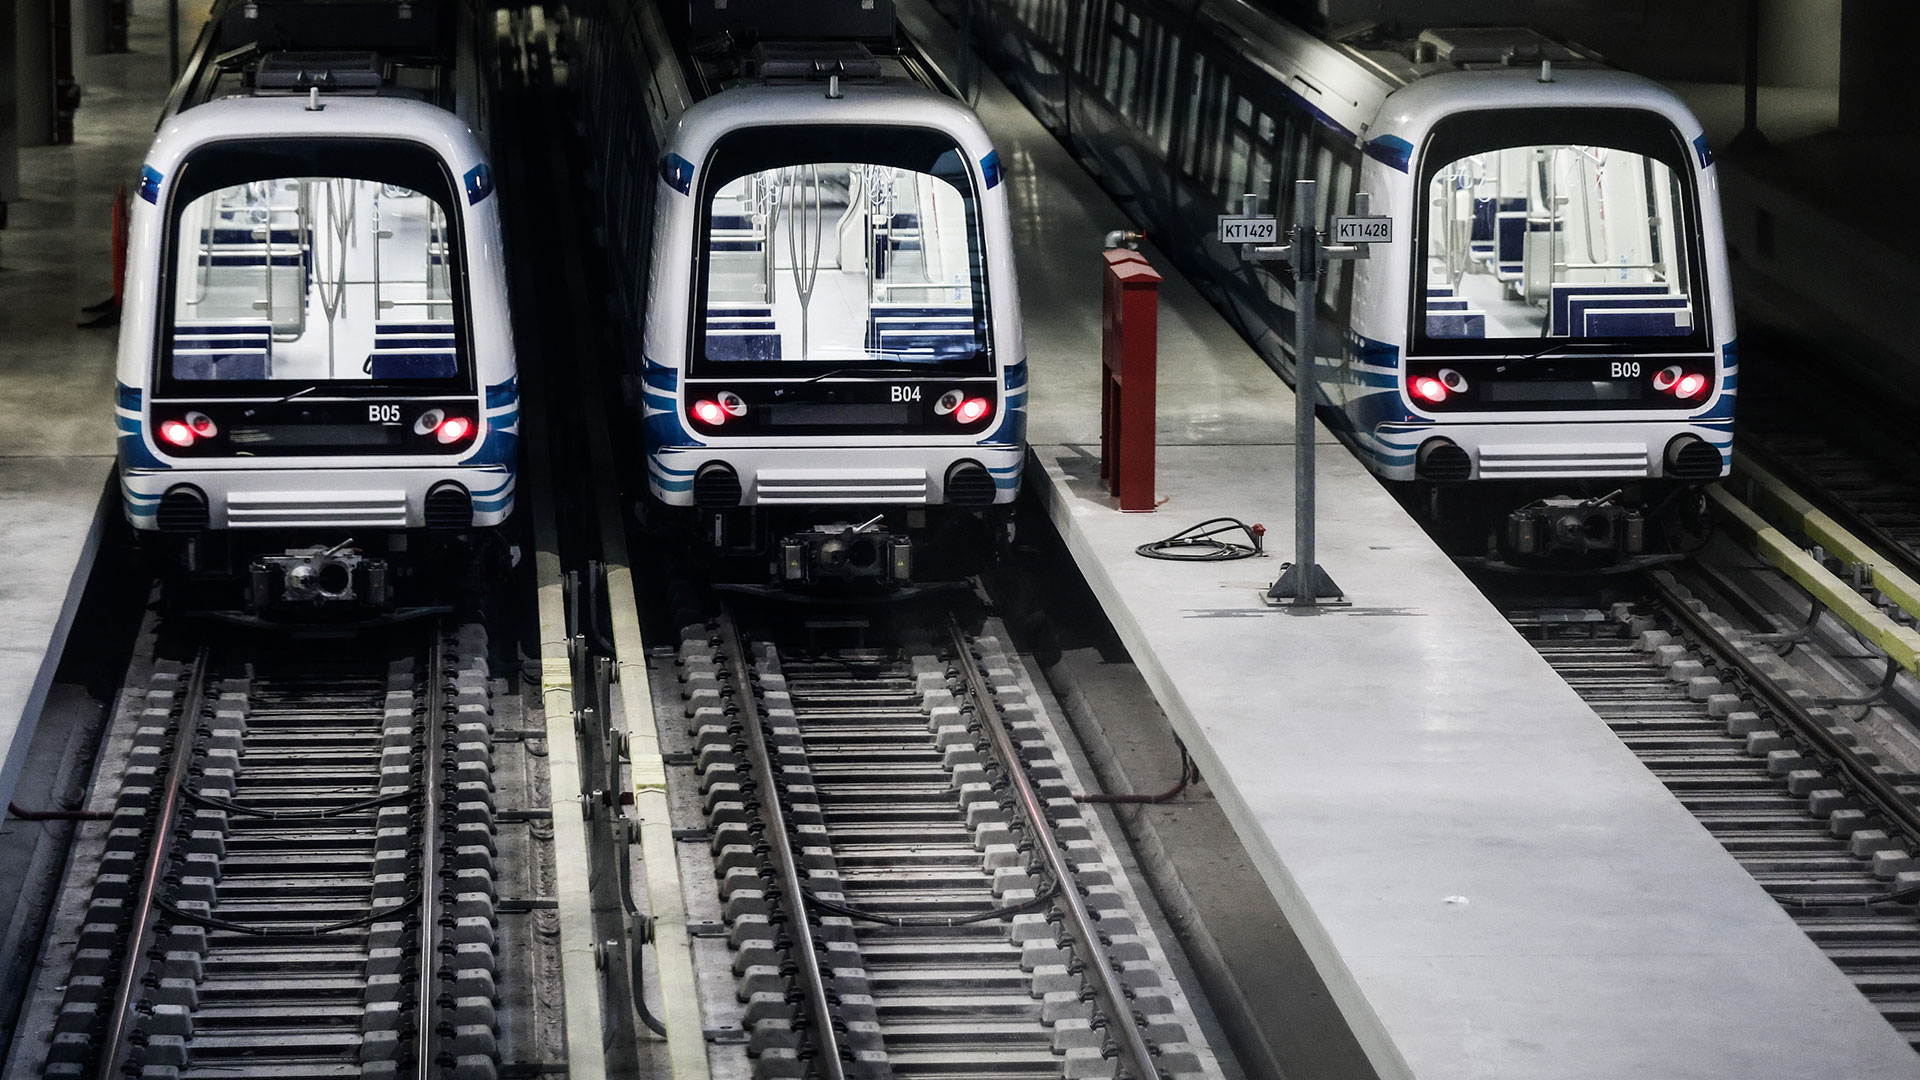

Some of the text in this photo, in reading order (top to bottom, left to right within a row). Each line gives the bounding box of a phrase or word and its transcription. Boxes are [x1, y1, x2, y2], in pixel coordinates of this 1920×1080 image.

[1225, 224, 1273, 238] KT1429
[1340, 223, 1388, 237] KT1428
[1611, 362, 1640, 377] B09
[891, 385, 921, 402] B04
[369, 404, 400, 421] B05
